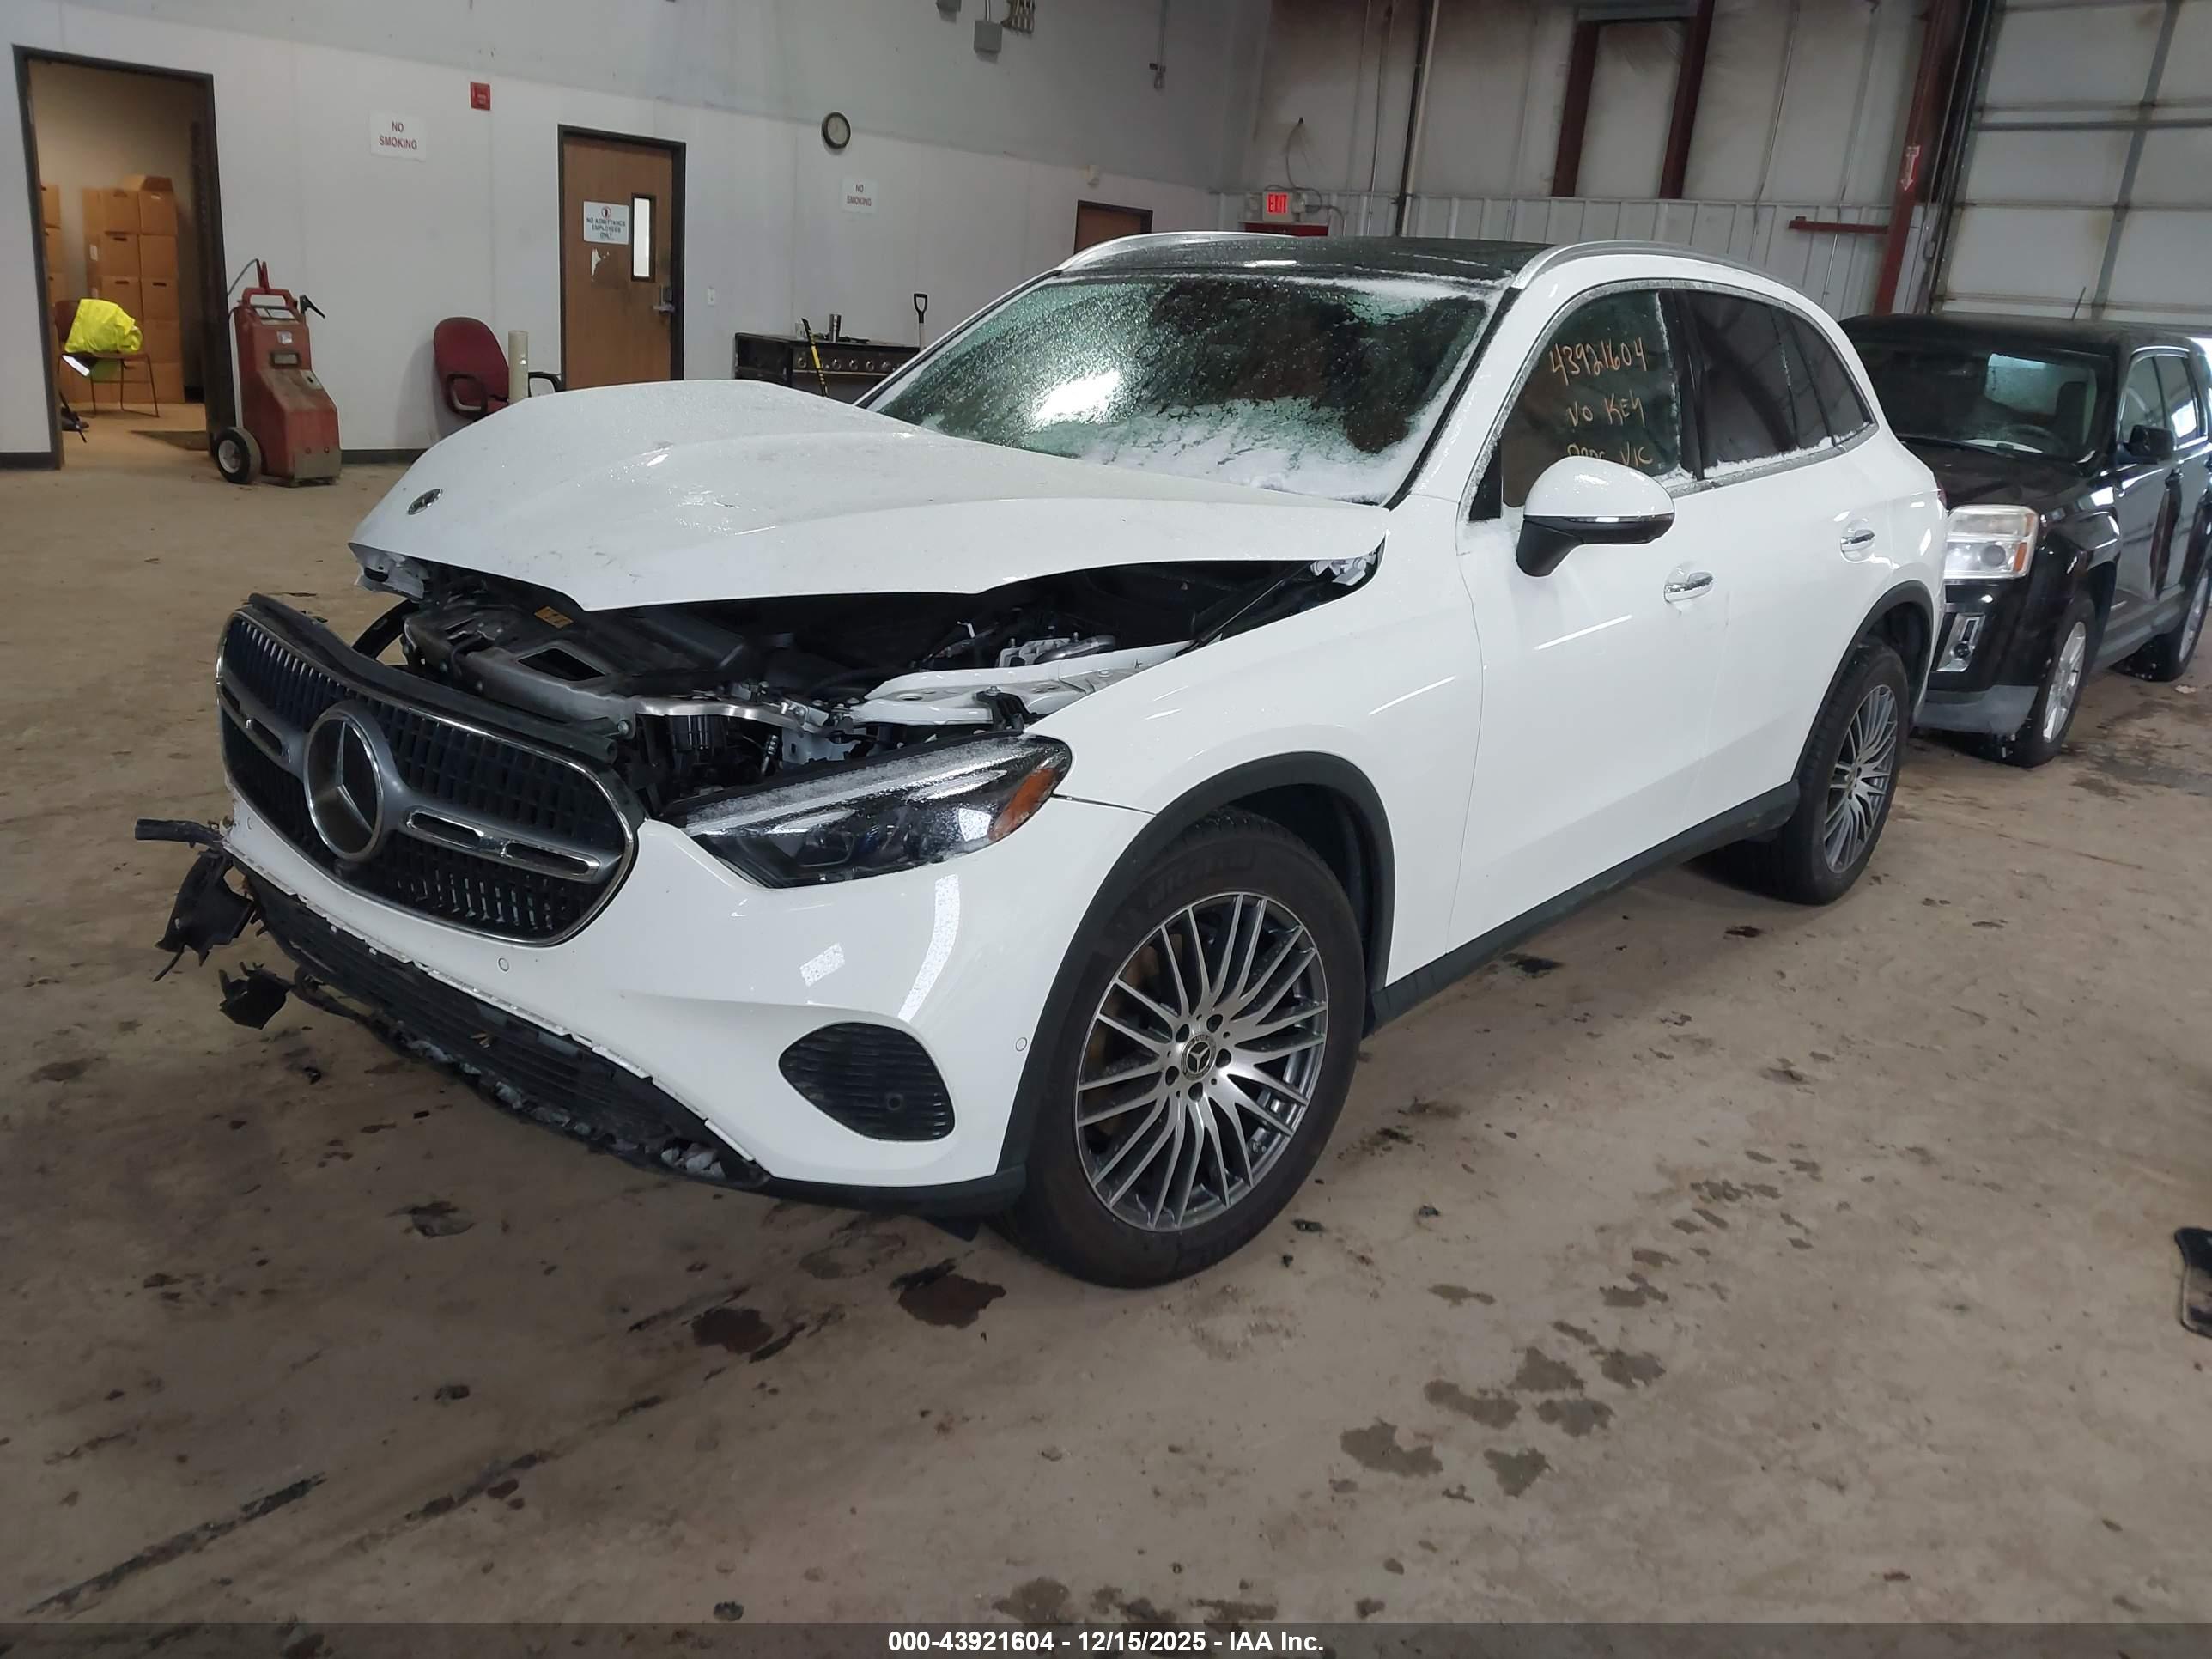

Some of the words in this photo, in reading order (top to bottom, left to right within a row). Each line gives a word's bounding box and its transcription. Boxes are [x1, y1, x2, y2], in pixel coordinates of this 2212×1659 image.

[392, 121, 404, 132] NO
[379, 135, 417, 150] SMOKING
[1549, 337, 1647, 386] 43921604
[1604, 389, 1645, 427] KEY
